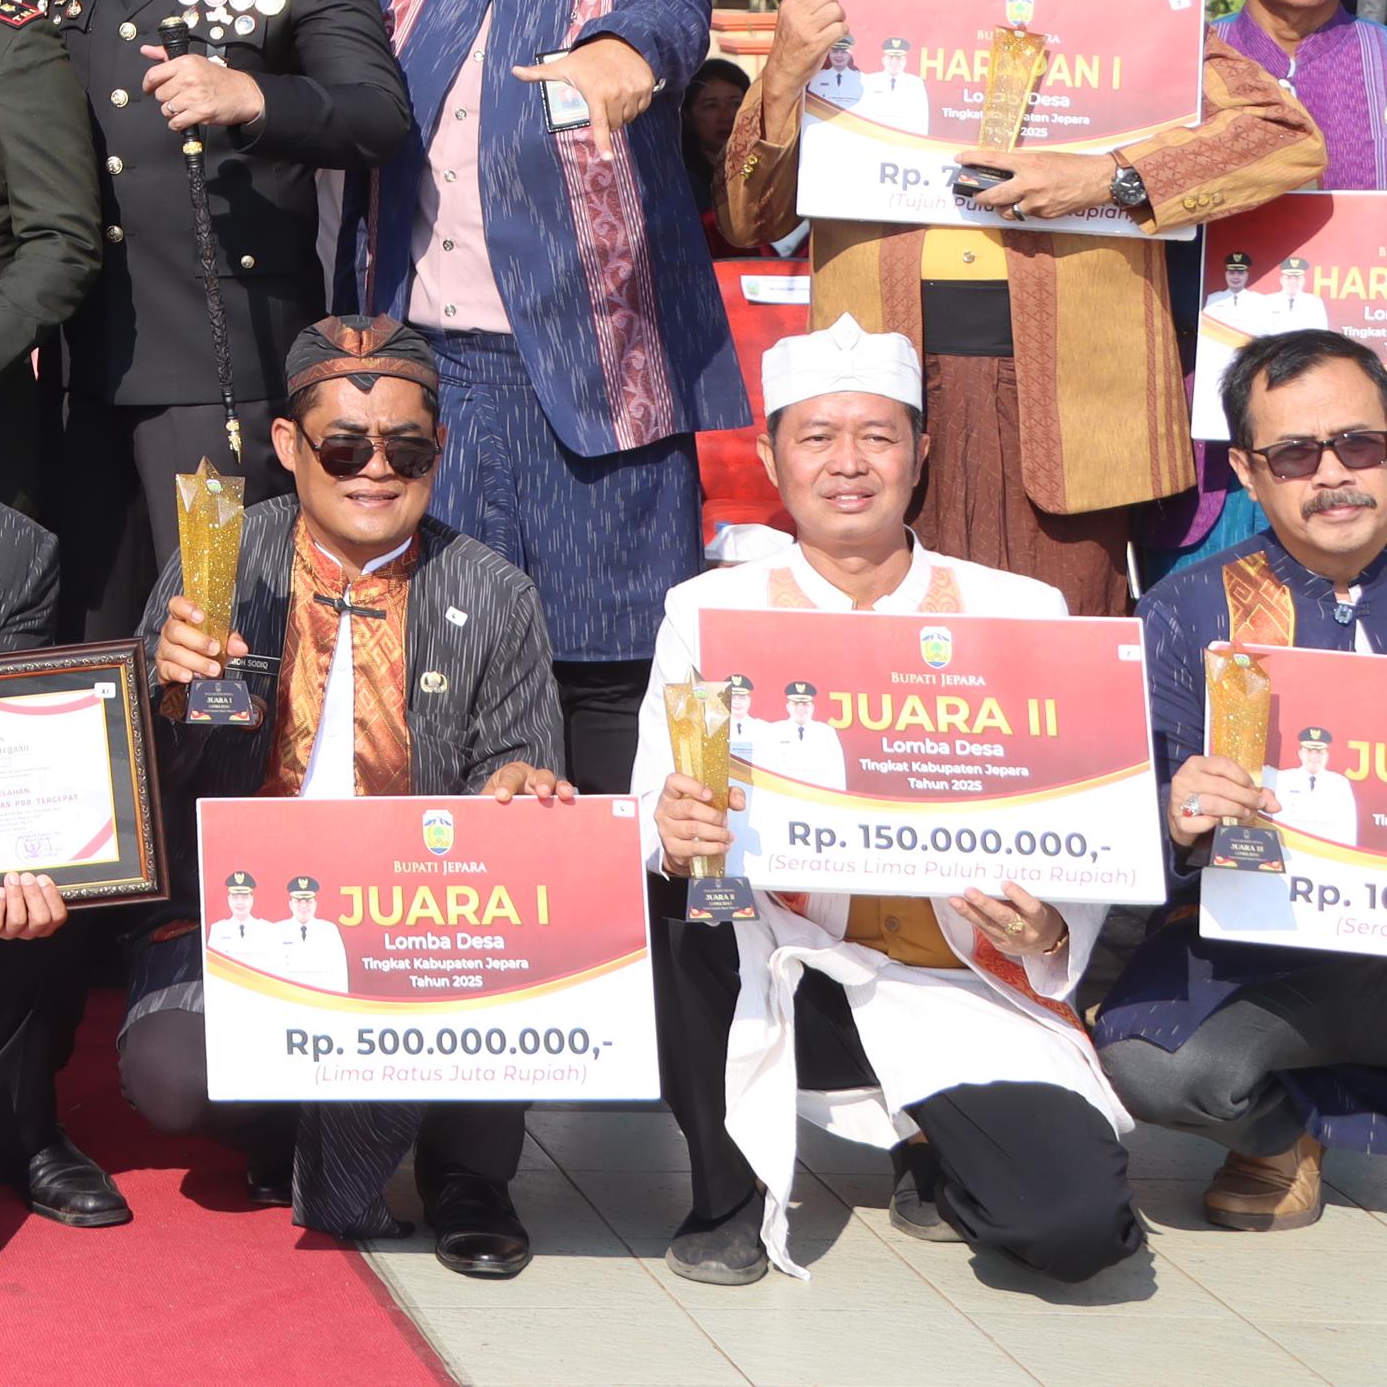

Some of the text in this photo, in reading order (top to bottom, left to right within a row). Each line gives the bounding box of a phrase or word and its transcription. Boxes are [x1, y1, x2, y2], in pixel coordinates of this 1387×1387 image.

[12, 8, 37, 21] TNI
[1027, 93, 1070, 108] Desa
[1051, 114, 1090, 126] Jepara
[1020, 126, 1048, 138] 2025
[879, 162, 930, 191] Rp.
[247, 659, 268, 670] SODIQ
[891, 672, 986, 688] BUPATI JEPARA
[827, 692, 1058, 737] JUARA II
[881, 737, 1004, 757] Lomba Desa
[859, 758, 1029, 777] Tingkat Kabupaten Jepara
[908, 777, 983, 792] Tahun 2025
[36, 794, 78, 805] TERCEPAT
[787, 820, 1112, 864] Rp. 150.000.000,-
[393, 860, 487, 875] BUPATI JEPARA
[768, 852, 1139, 889] (Seratus Lima Puluh Juta Rupiah)
[1289, 876, 1351, 912] Rp.
[338, 885, 550, 927] JUARA I
[385, 933, 505, 951] Lomba Desa
[362, 957, 529, 972] Tingkat Kabupaten Jepara
[410, 975, 483, 988] Tahun 2025
[285, 1027, 614, 1063] Rp. 500.000.000,-
[315, 1064, 588, 1086] (Lima Ratus Juta Rupiah)
